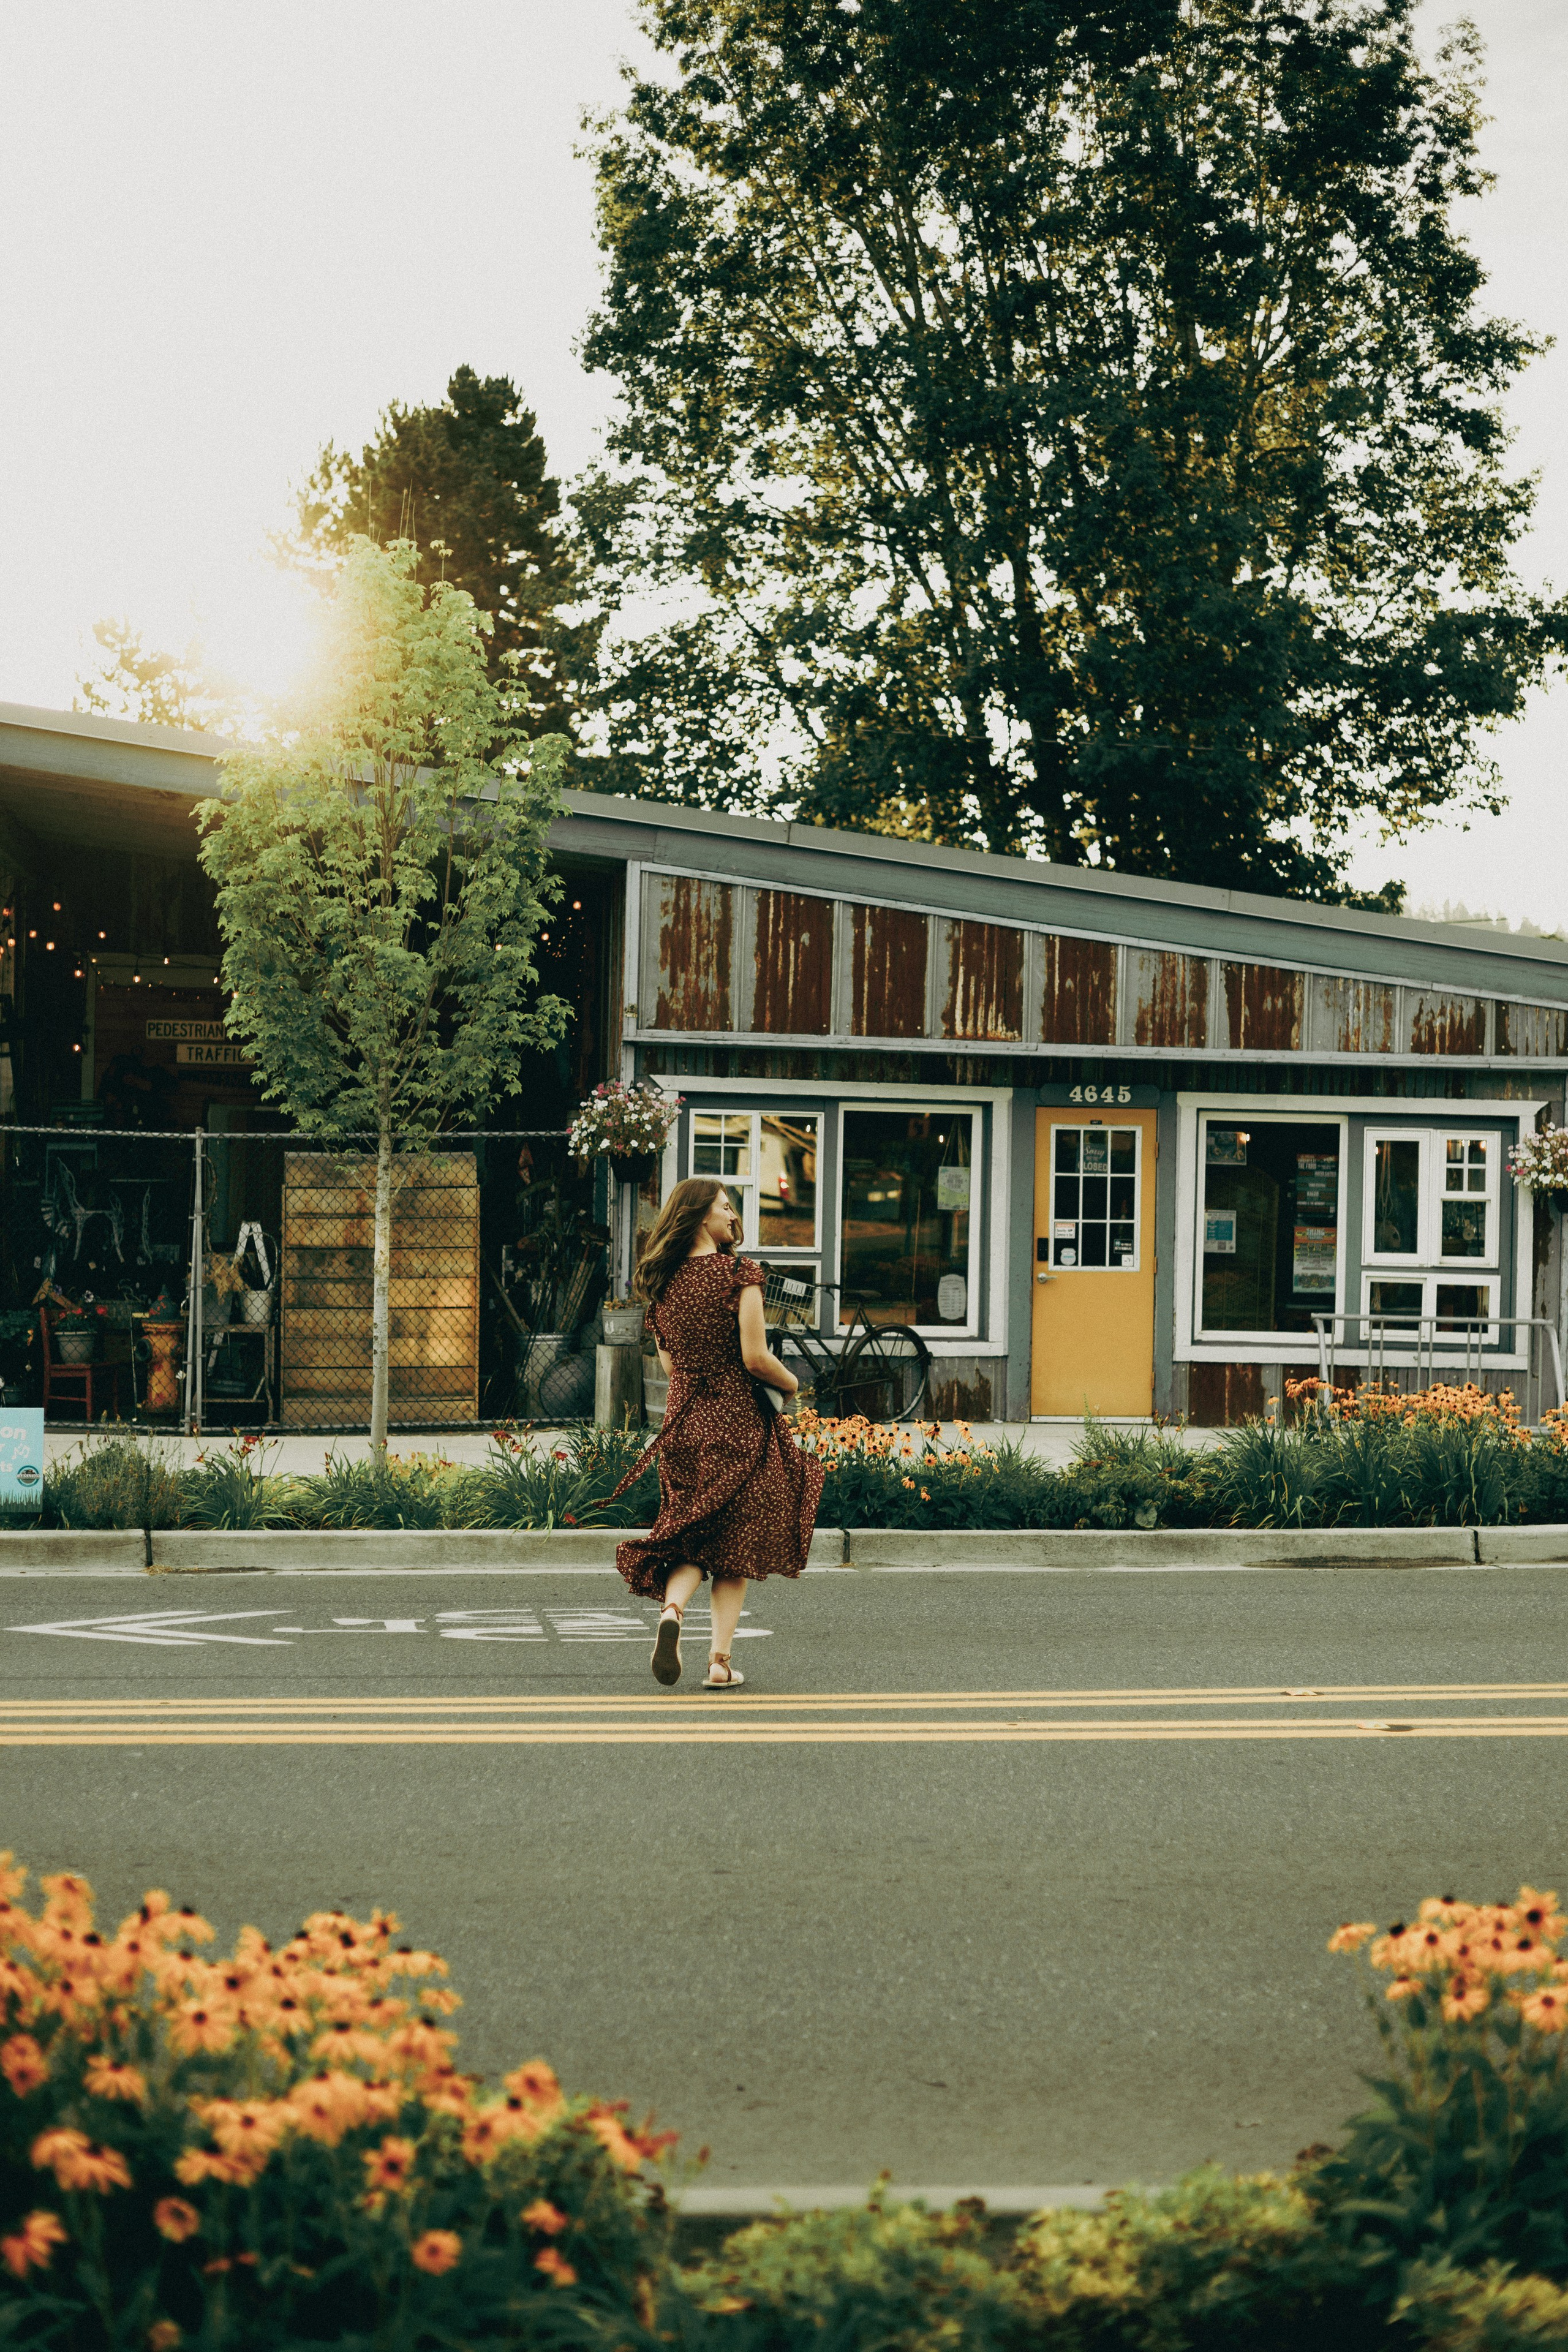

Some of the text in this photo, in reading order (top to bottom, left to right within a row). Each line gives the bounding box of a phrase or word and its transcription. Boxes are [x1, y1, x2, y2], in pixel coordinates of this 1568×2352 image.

[148, 1022, 224, 1038] PEDESTRIAN
[186, 1046, 246, 1062] TRAFFIC
[1069, 1085, 1132, 1103] 4645
[1084, 1145, 1105, 1159] Sorry
